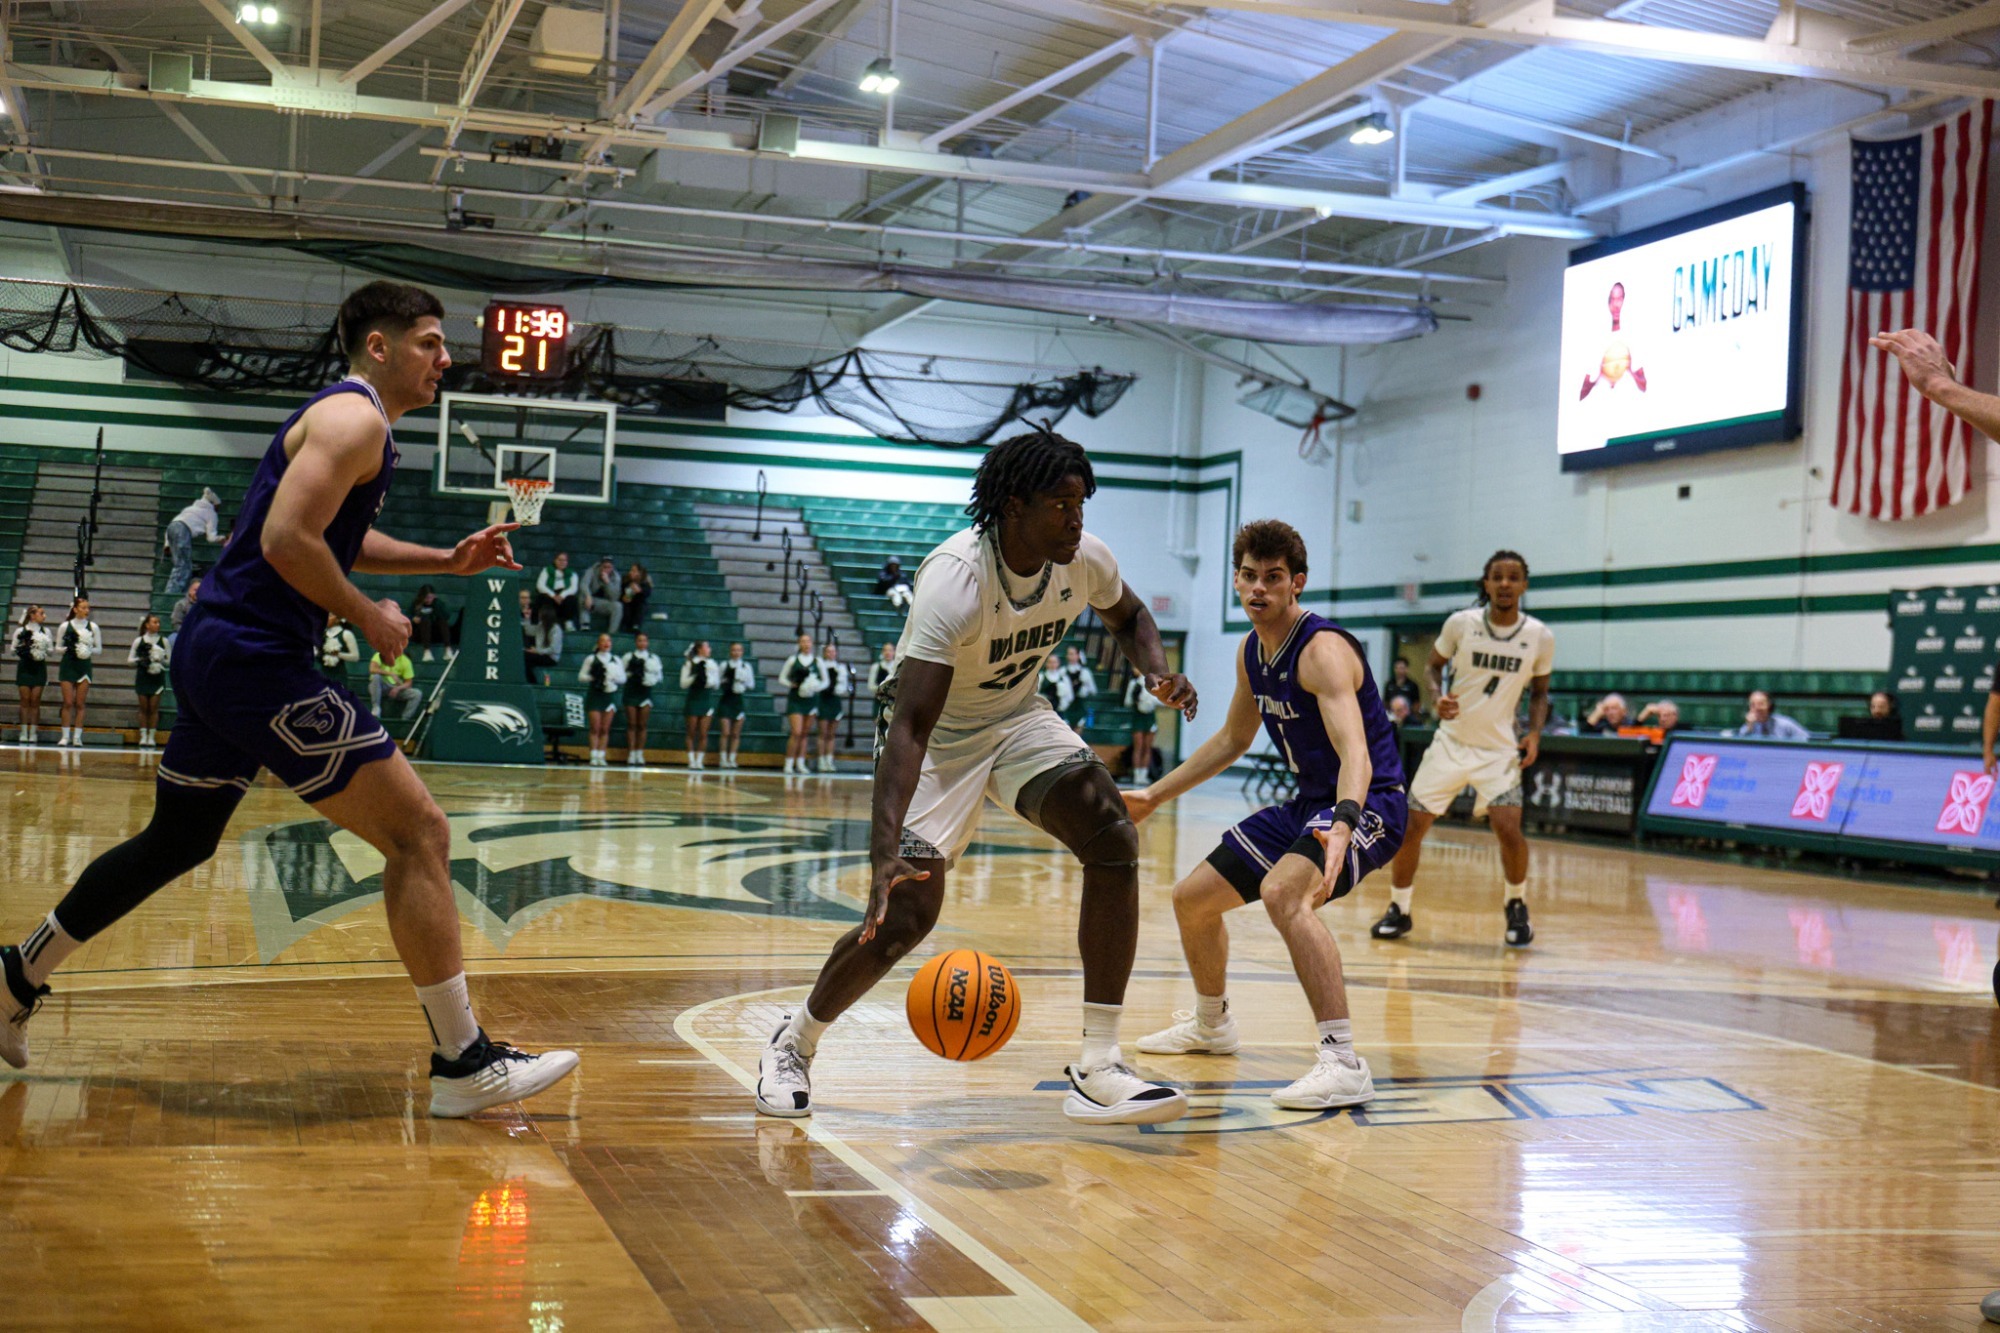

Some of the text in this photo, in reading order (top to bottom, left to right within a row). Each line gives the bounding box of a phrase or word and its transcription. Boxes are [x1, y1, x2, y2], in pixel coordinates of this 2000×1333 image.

[1672, 242, 1774, 333] GAMEDAY
[501, 335, 547, 372] 21
[485, 578, 506, 681] WAGNER
[988, 618, 1067, 665] WAGNER
[1471, 651, 1523, 673] WAGNER
[1482, 675, 1501, 699] 4
[946, 967, 970, 1021] NCAA
[977, 965, 1007, 1037] Wilson
